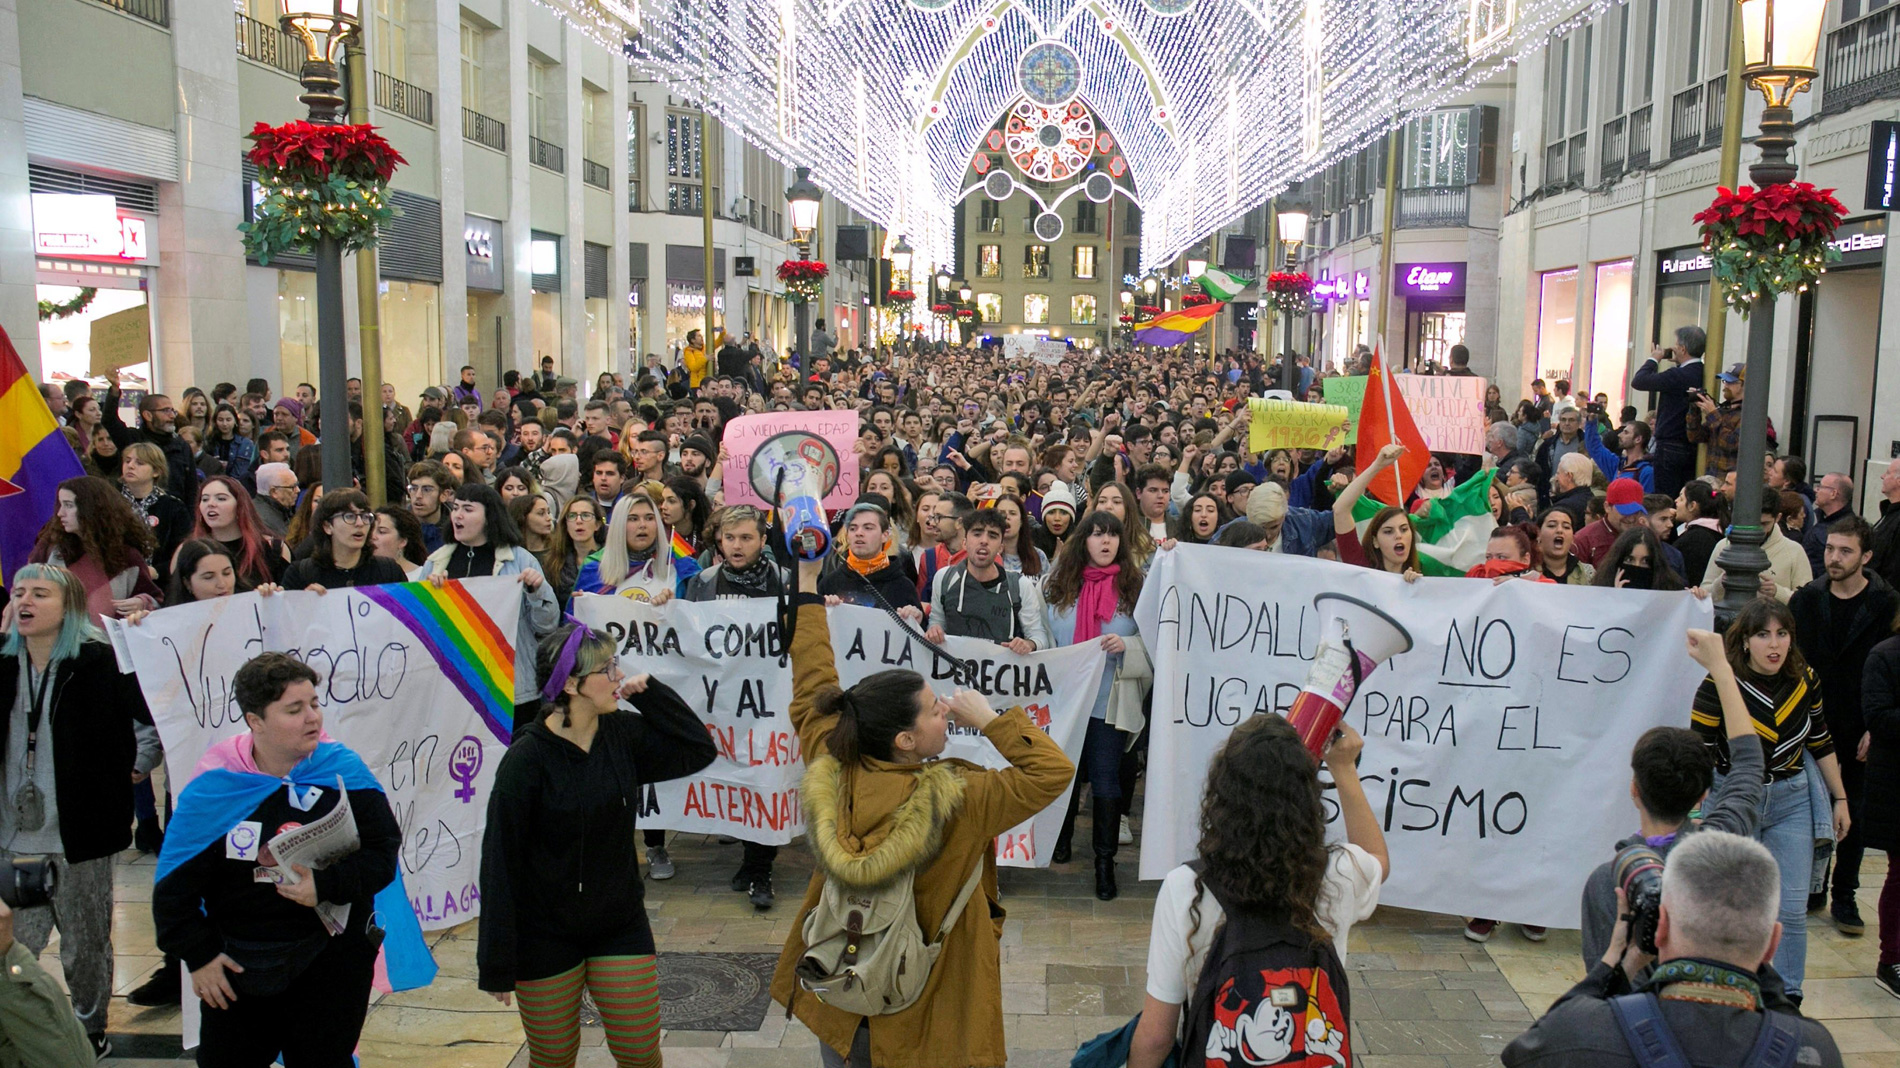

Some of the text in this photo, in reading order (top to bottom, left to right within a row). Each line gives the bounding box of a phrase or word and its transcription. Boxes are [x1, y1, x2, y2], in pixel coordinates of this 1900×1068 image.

[1851, 233, 1886, 251] Bear
[734, 424, 745, 438] SI
[818, 423, 850, 437] EDAD
[1266, 426, 1320, 448] 1936
[991, 604, 1008, 618] NYC
[605, 620, 685, 657] PARA
[845, 627, 866, 661] A
[881, 629, 913, 669] LA
[931, 650, 1053, 697] DERECHA
[1442, 617, 1517, 682] NO
[1557, 625, 1636, 684] ES
[701, 674, 775, 719] Y AL
[1364, 691, 1457, 747] PARA
[1498, 706, 1562, 750] EL
[388, 735, 438, 791] en
